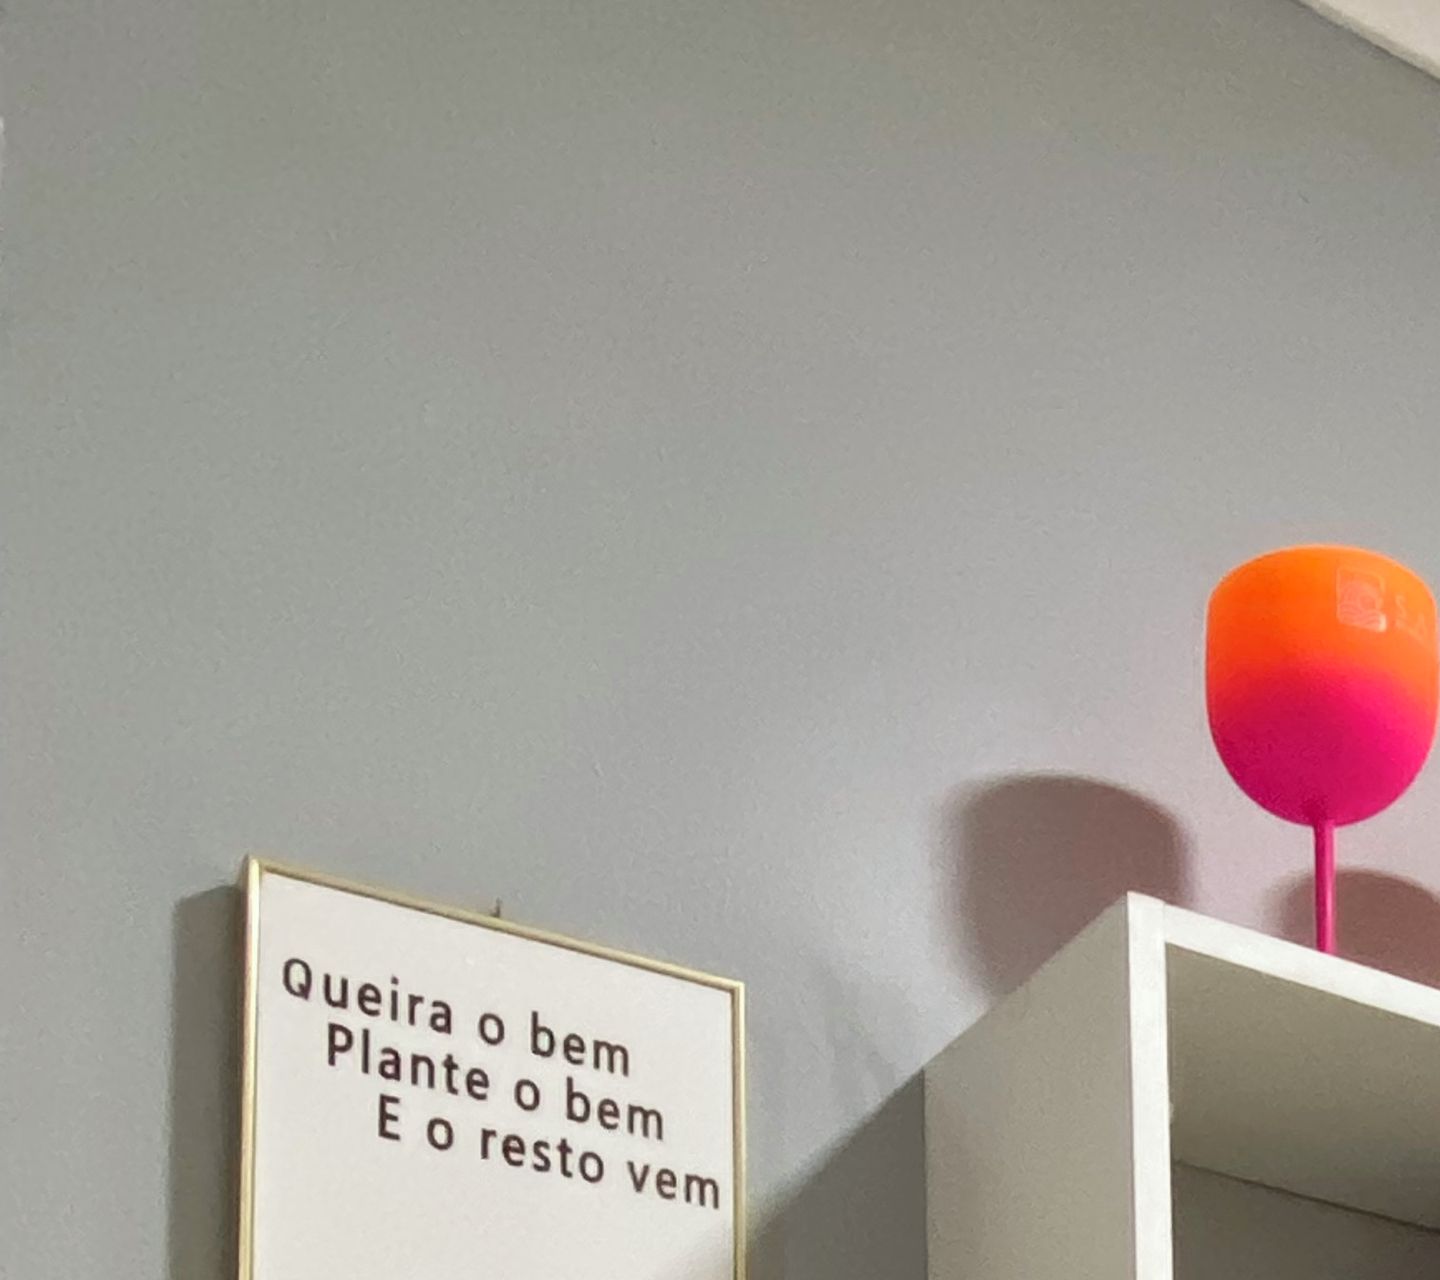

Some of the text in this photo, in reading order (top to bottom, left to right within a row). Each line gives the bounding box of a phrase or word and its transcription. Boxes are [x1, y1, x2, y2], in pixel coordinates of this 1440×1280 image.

[283, 957, 630, 1077] Queira o bem
[327, 1022, 664, 1142] Plante o bem
[378, 1093, 720, 1209] E o resto vem
